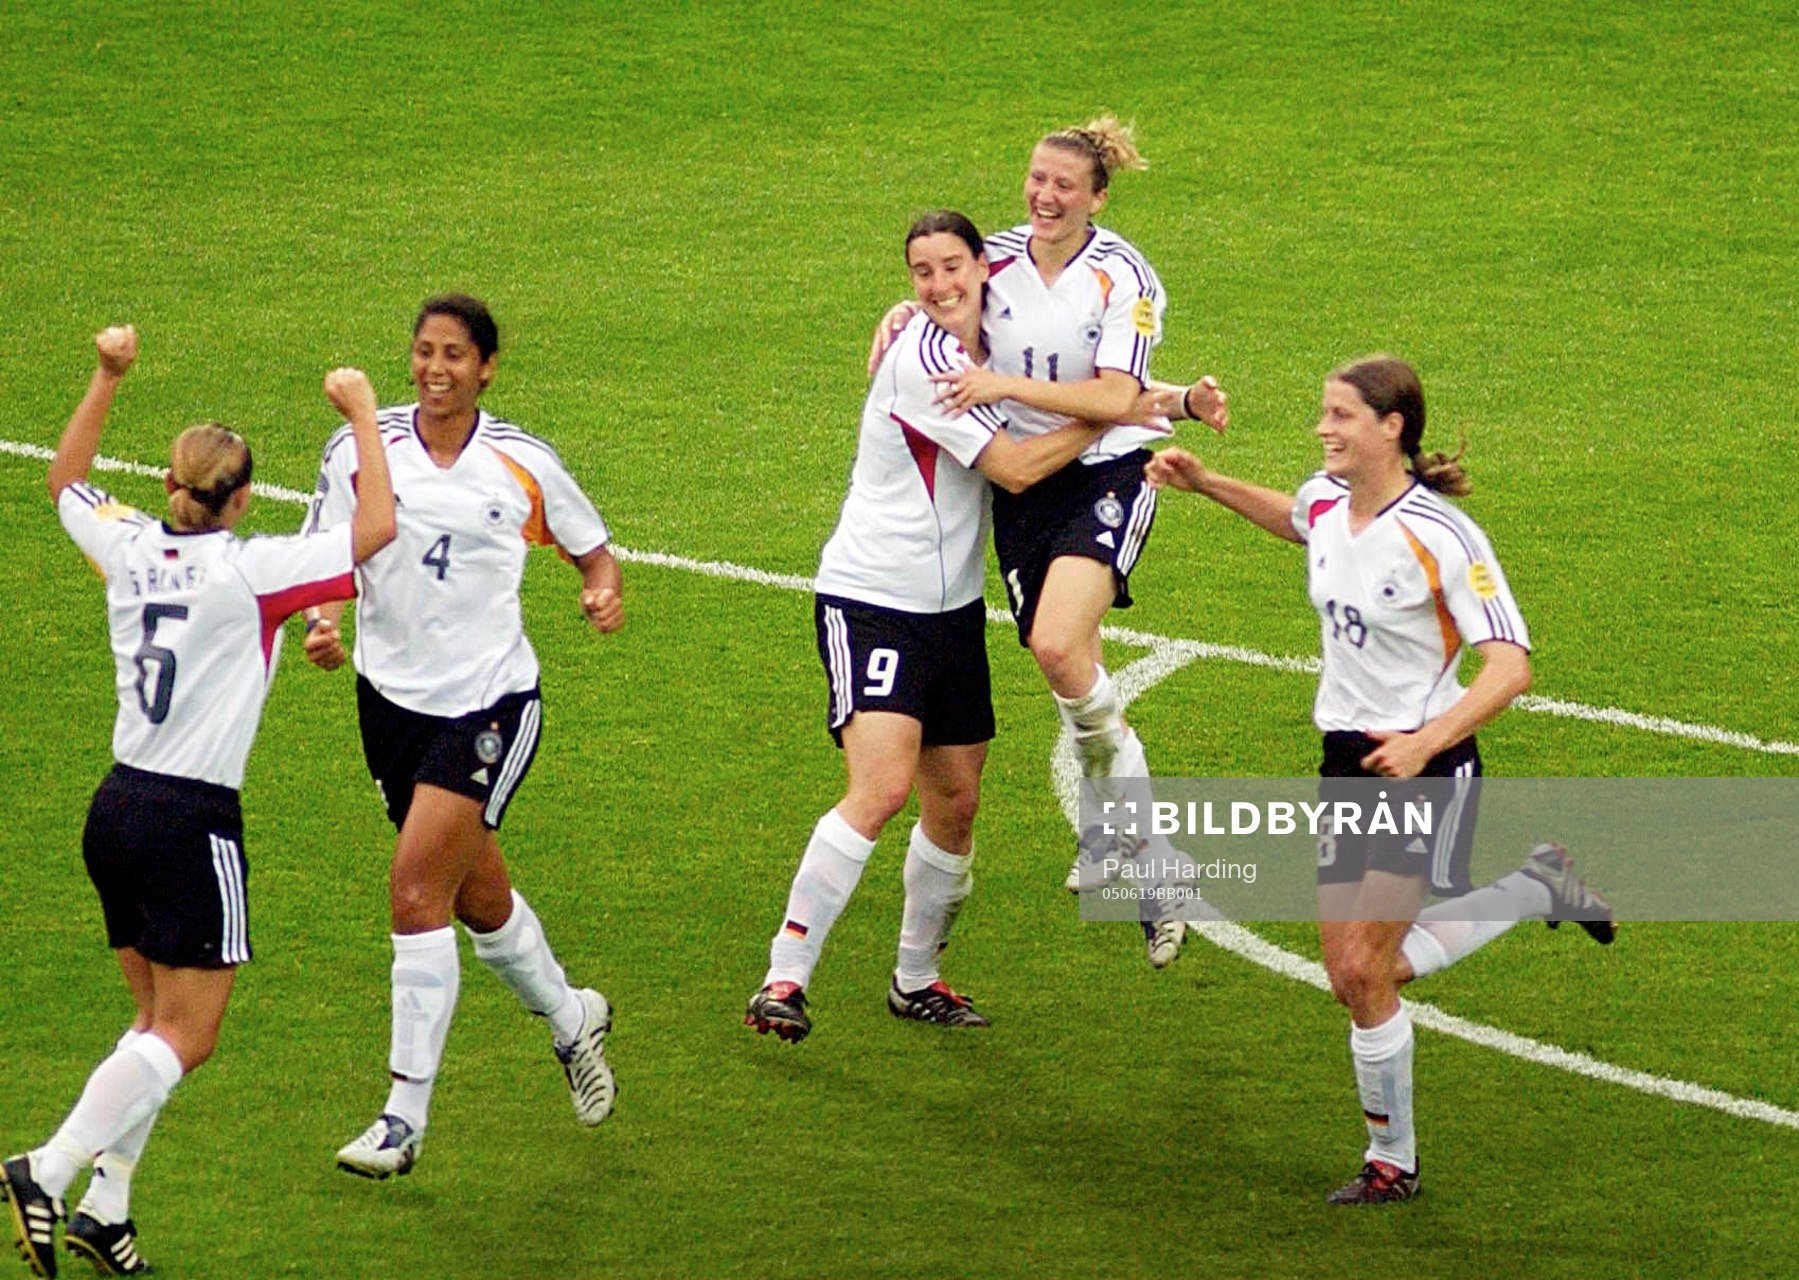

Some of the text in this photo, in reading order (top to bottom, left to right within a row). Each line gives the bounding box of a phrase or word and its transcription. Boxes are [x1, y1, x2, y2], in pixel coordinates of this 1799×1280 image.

[1023, 346, 1059, 382] 11
[422, 533, 452, 581] 4
[1326, 599, 1367, 649] 18
[863, 648, 899, 697] 9
